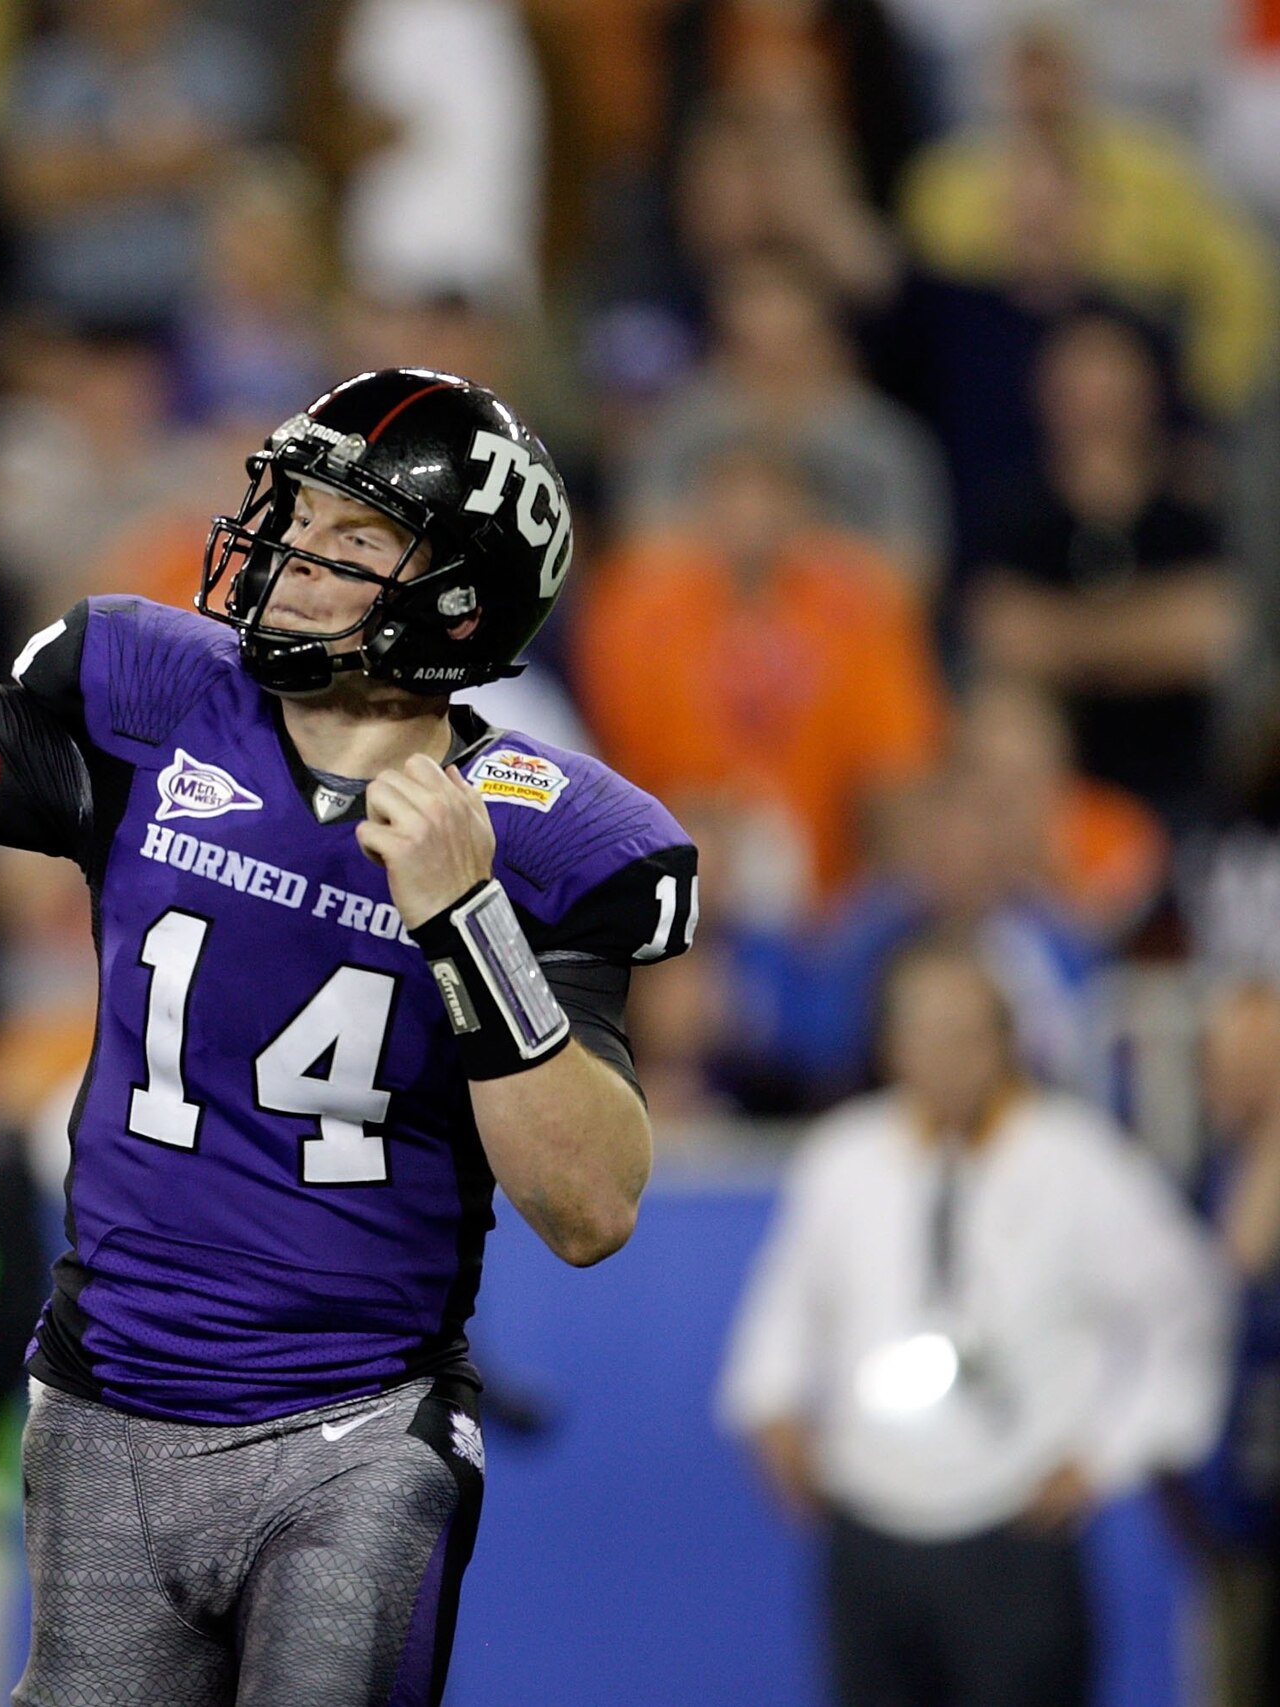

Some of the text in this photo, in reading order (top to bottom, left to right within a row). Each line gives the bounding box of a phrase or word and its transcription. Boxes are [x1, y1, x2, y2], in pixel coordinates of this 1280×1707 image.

[464, 430, 573, 598] TCU
[194, 794, 223, 807] WEST
[140, 823, 308, 909] HORNED
[433, 962, 468, 1029] CUTTERS
[128, 910, 396, 1184] 14
